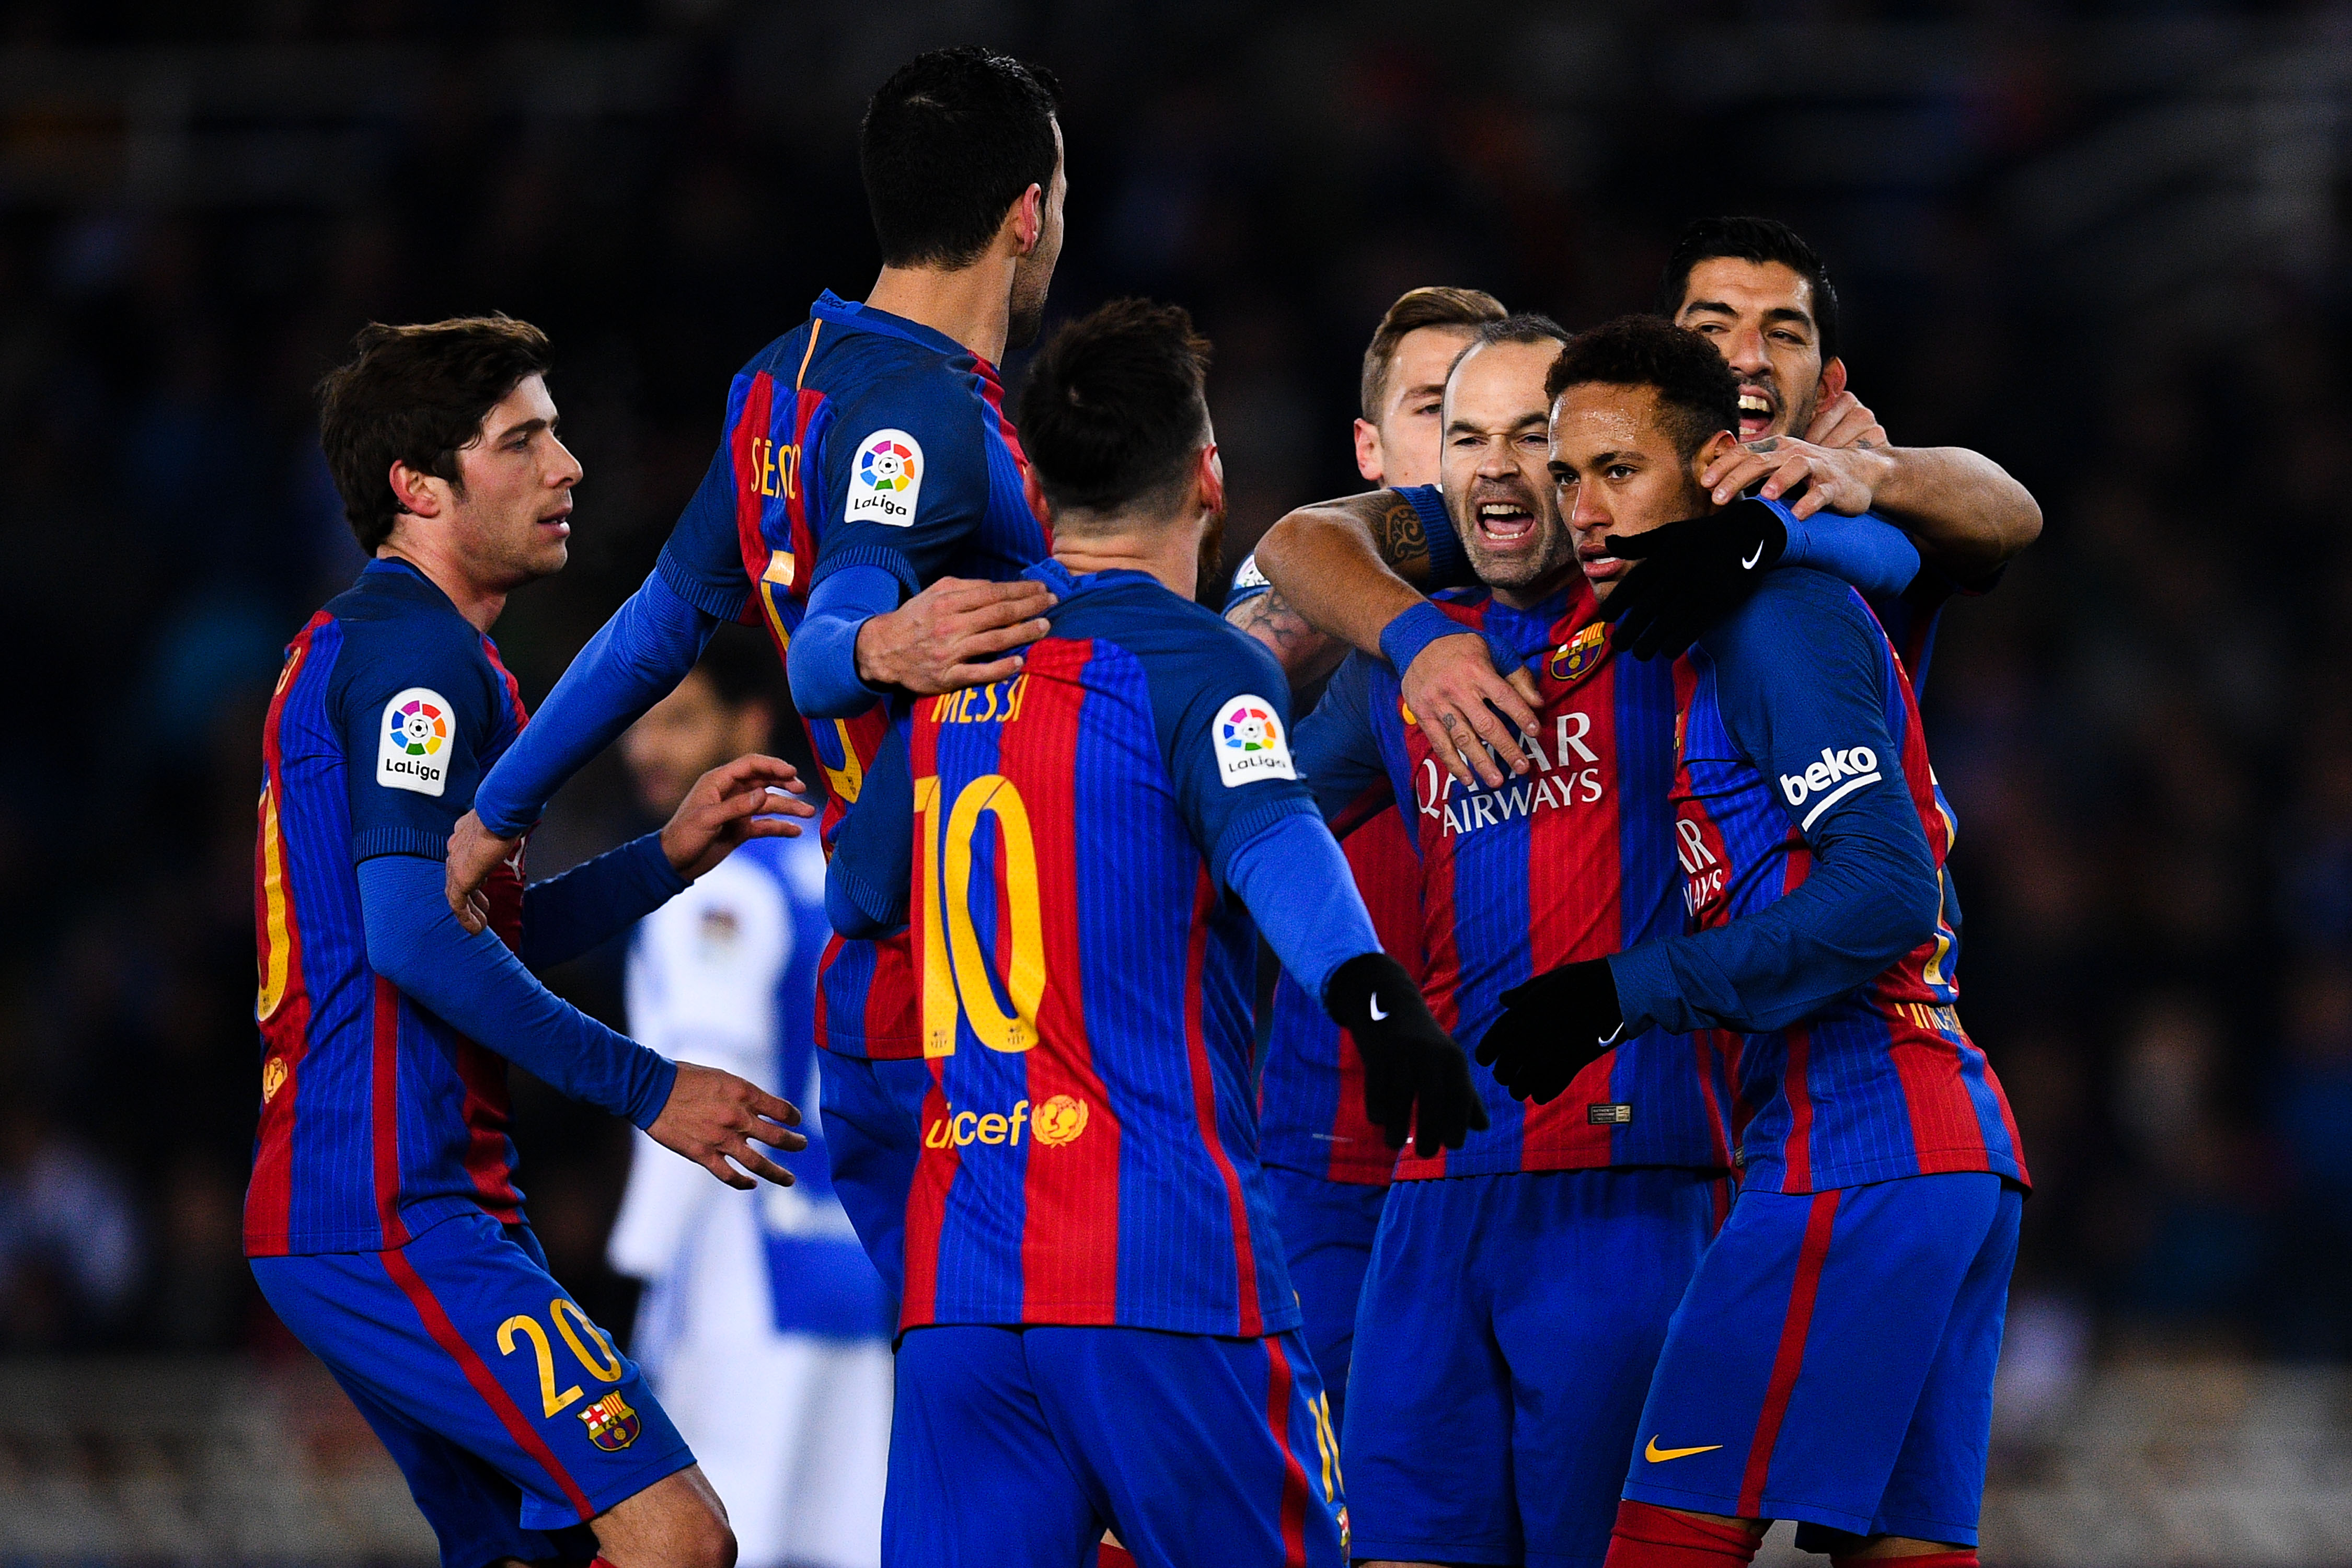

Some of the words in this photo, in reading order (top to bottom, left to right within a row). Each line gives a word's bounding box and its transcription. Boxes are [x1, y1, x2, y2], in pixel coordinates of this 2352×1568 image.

[854, 494, 907, 515] LaLiga
[930, 673, 1030, 723] MESSI
[386, 758, 441, 781] LaLiga
[1779, 746, 1877, 806] beko
[1443, 768, 1602, 837] AIRWAYS
[914, 774, 1047, 1059] 10
[925, 1100, 1029, 1149] uicef
[496, 1298, 622, 1419] 20
